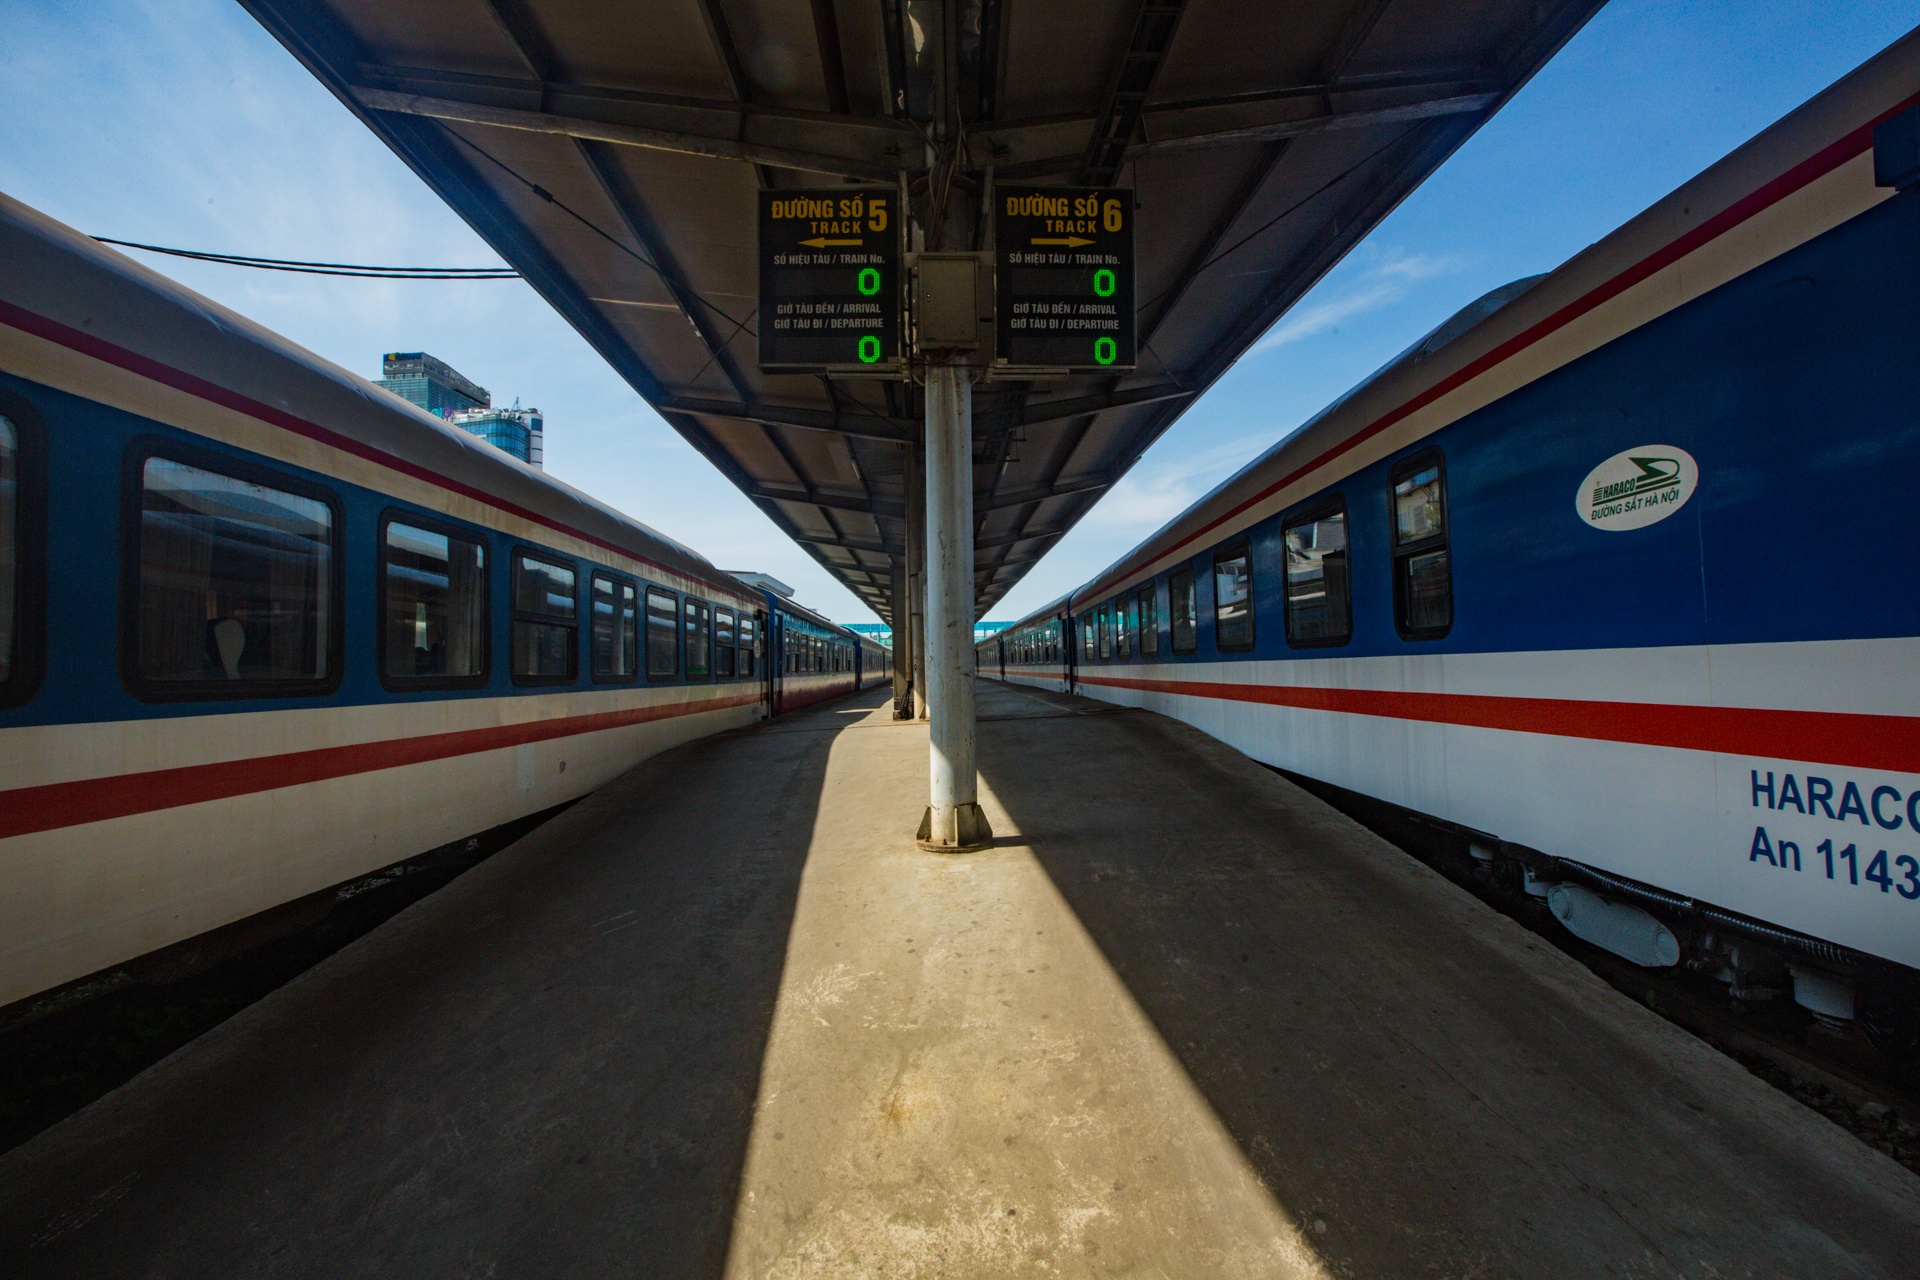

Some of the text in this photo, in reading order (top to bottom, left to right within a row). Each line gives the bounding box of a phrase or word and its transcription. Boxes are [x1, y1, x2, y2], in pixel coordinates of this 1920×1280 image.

[771, 193, 888, 232] ĐƯỜNG SỐ 5
[1007, 192, 1122, 232] ĐƯỜNG SỐ 6
[811, 221, 862, 234] TRACK
[1046, 220, 1097, 233] TRACK
[774, 252, 885, 266] SỐ HIỆU TÀU / TRAIN No.
[1010, 251, 1120, 266] SỐ HIỆU TÀU / TRAIN No.
[858, 268, 881, 296] 0
[1093, 269, 1117, 297] 0
[777, 301, 881, 314] GIỜ TÀU ĐẾN / ARRIVAL
[1013, 301, 1117, 315] GIỜ TÀU ĐẾN / ARRIVAL
[774, 317, 884, 329] GIỜ TÀU ĐI / DEPARTURE
[1011, 318, 1119, 330] GIỜ TÀU ĐI / DEPARTURE
[858, 335, 881, 363] 0
[1094, 337, 1117, 364] 0
[1603, 478, 1636, 499] HARACO
[1591, 503, 1622, 520] ĐƯỜNG
[1644, 492, 1658, 508] HÀ
[1661, 487, 1679, 504] NỘI
[1749, 826, 1920, 900] An 1143
